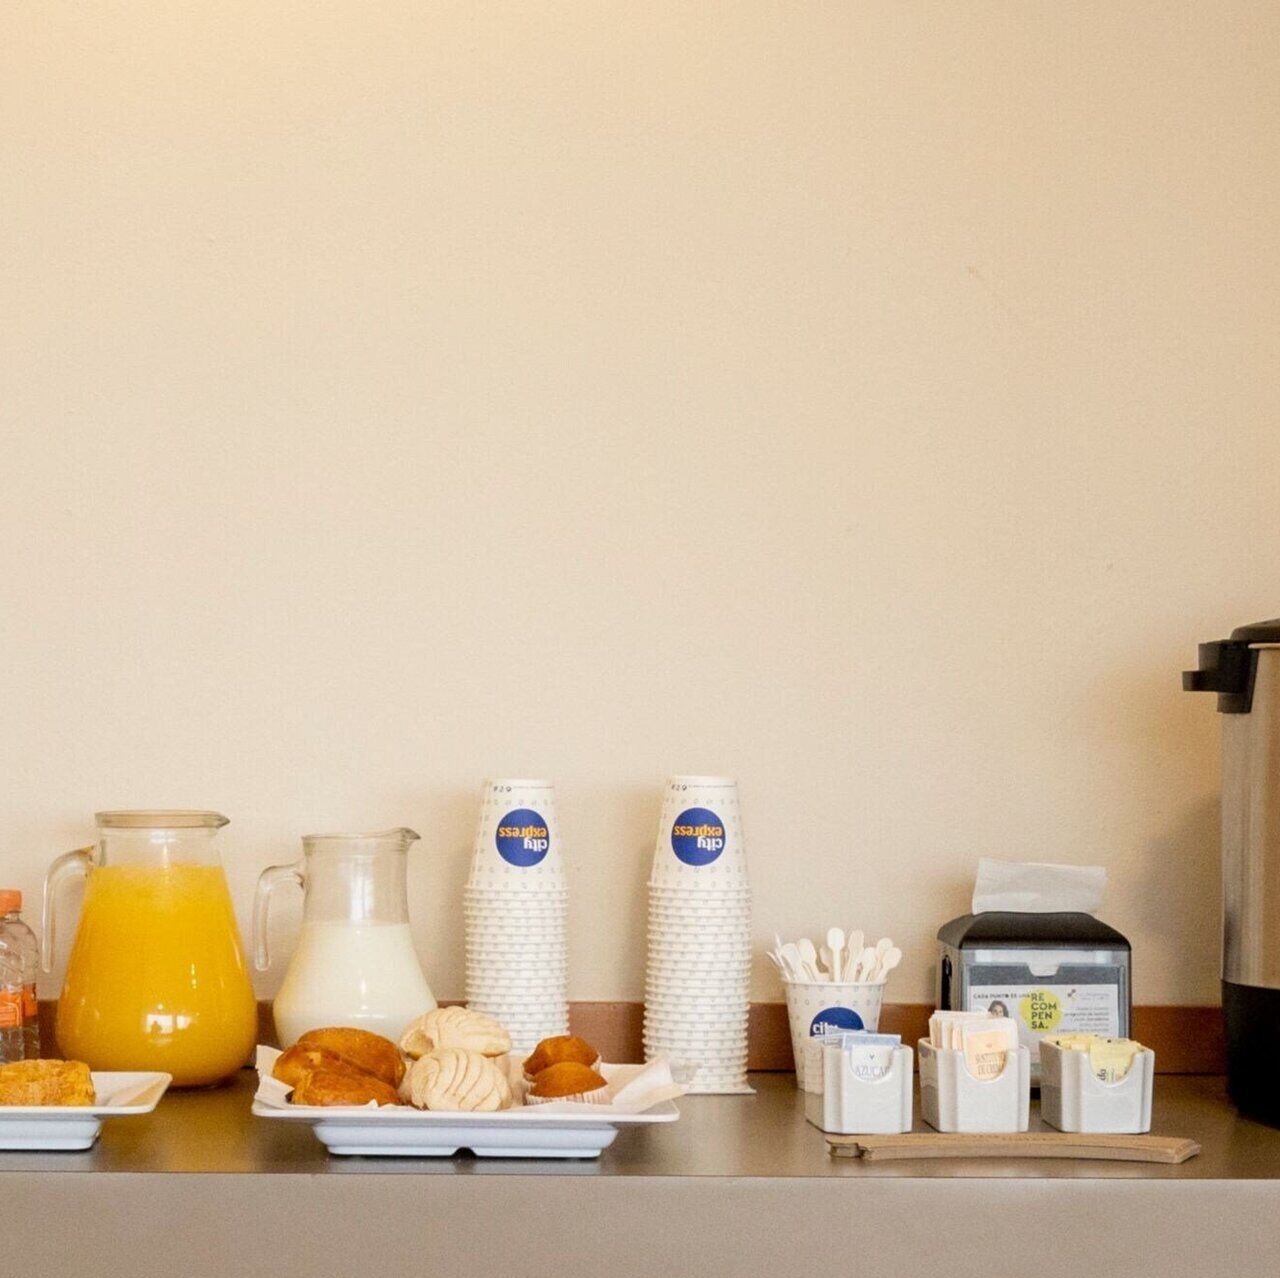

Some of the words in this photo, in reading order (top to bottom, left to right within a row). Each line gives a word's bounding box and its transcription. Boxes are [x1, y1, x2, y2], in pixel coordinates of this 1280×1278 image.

[499, 825, 547, 838] express
[673, 824, 723, 837] express
[523, 837, 547, 852] city
[697, 835, 723, 851] city
[1031, 992, 1045, 1001] RE
[1031, 1002, 1057, 1011] COM
[1031, 1011, 1053, 1020] PEN
[1031, 1020, 1049, 1029] SA.
